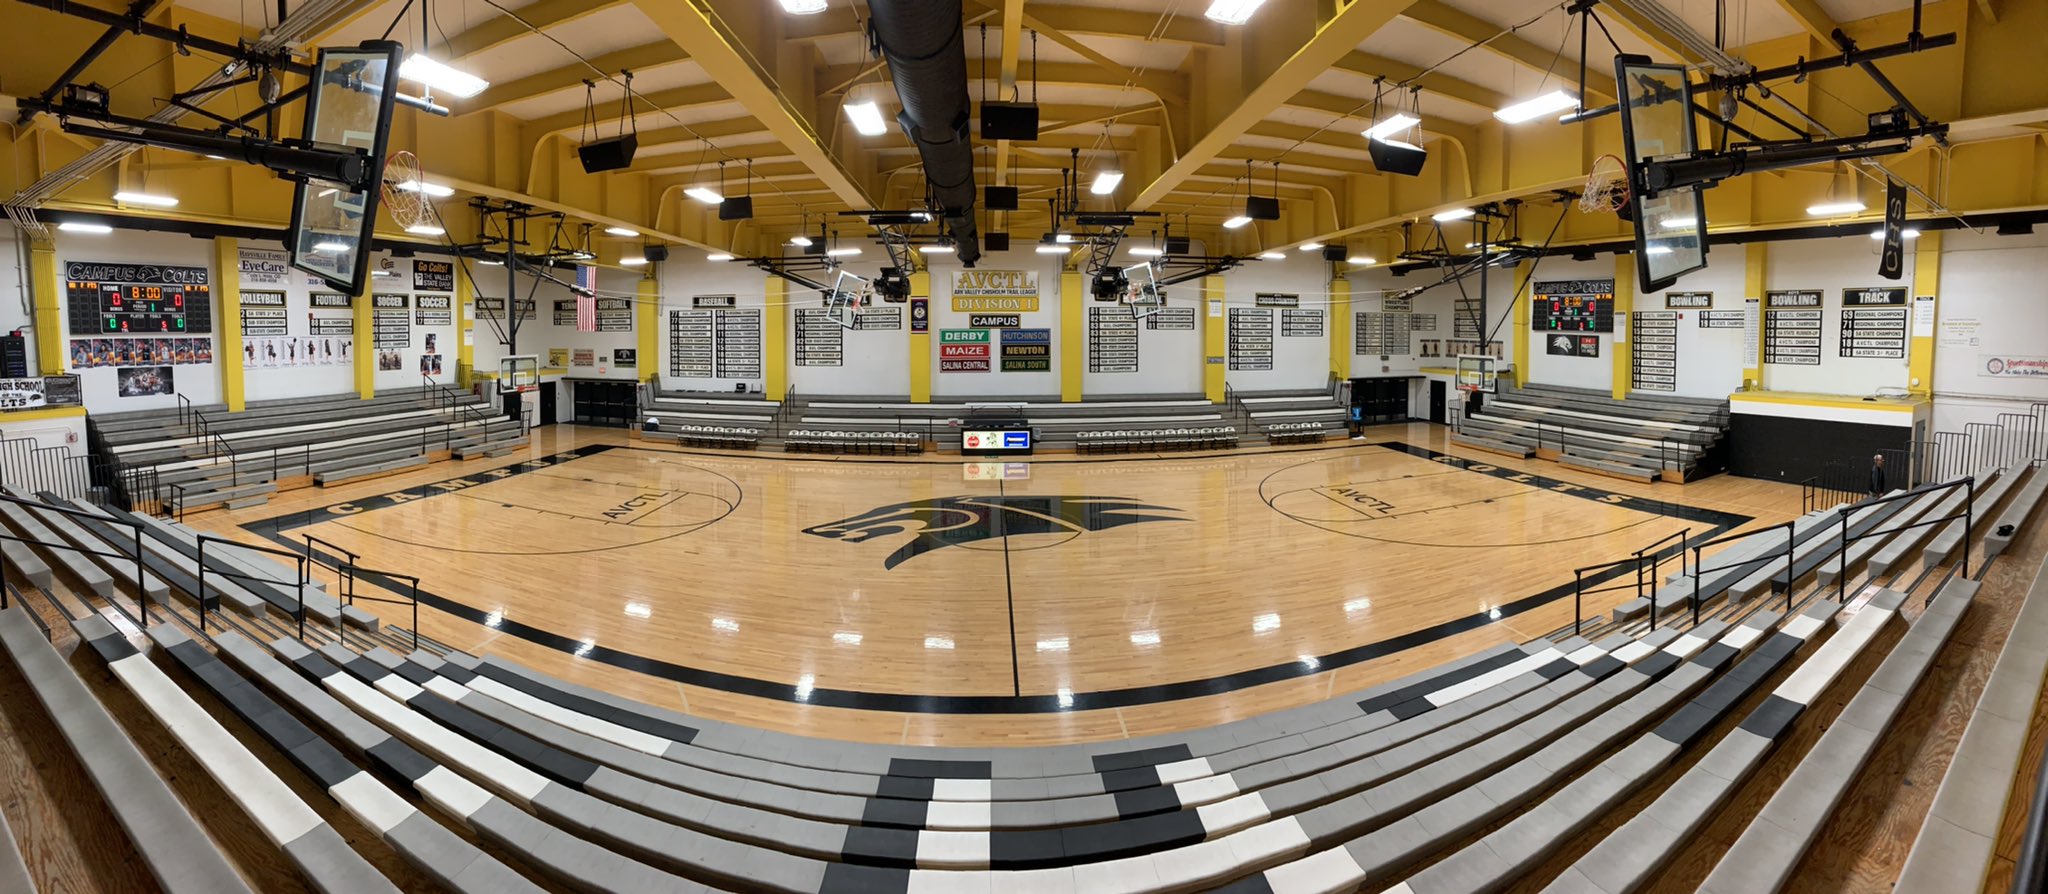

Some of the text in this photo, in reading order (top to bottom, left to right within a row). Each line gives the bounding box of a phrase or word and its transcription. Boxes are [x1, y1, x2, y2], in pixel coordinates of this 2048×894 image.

[1886, 197, 1903, 272] CHS
[242, 260, 285, 272] EyeCare
[418, 262, 448, 273] Go Colts!
[68, 263, 208, 285] CAMPUS COLTS
[132, 286, 161, 299] 8:00
[1535, 282, 1611, 293] CAMPUS COLTS
[112, 293, 121, 305] 0
[174, 294, 182, 306] 0
[240, 293, 282, 304] VOLLEYBALL
[316, 296, 348, 306] FOOTBALL
[377, 296, 402, 306] SOCCER
[420, 297, 448, 308] SOCCER
[1564, 297, 1582, 306] 8:00
[1670, 296, 1708, 306] BOWLING
[1771, 295, 1817, 305] BOWLING
[1859, 292, 1890, 303] TRACK
[598, 300, 627, 309] SOFTBALL
[960, 299, 1032, 308] DIVISION I
[1843, 310, 1853, 319] 69
[110, 319, 116, 328] 0
[177, 319, 184, 328] 0
[972, 317, 1018, 326] CAMPUS
[1003, 332, 1048, 340] HUTCHINSON
[1842, 339, 1852, 347] 18
[15, 381, 45, 394] SCHOOL
[326, 453, 580, 515] CAMPUS
[1432, 456, 1633, 503] COLTS
[601, 492, 670, 520] AVCTL
[1330, 488, 1396, 514] AVCTL
